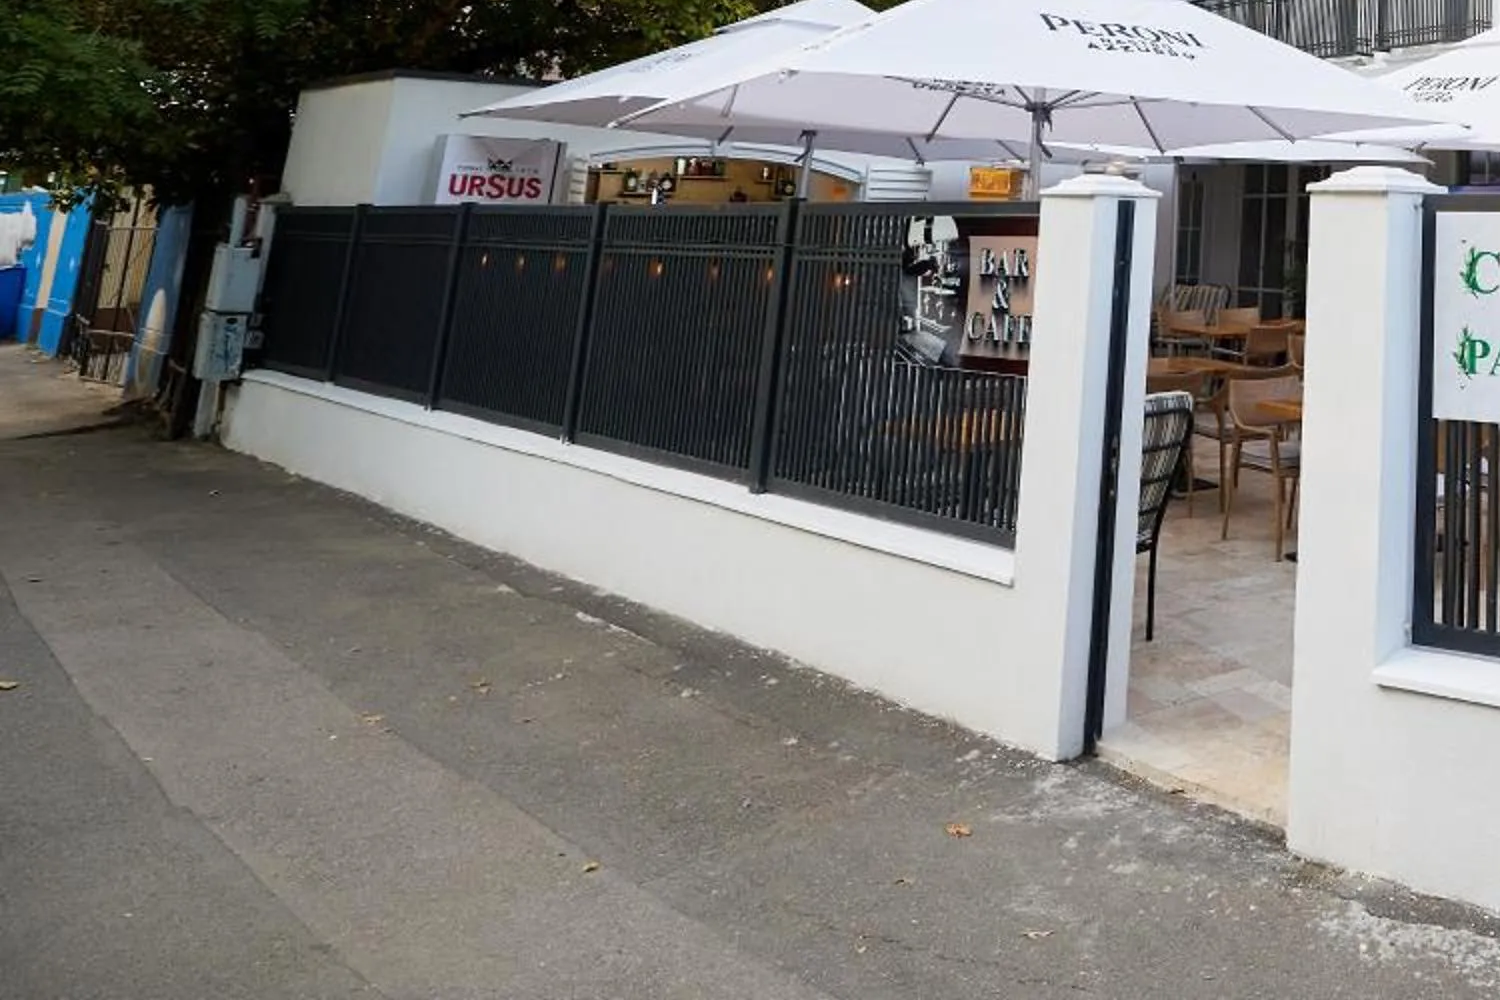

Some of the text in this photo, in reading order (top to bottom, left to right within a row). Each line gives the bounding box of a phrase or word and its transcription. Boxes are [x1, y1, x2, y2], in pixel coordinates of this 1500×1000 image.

[1039, 13, 1204, 48] PERONI
[448, 173, 542, 199] URSUS
[980, 248, 1030, 276] BAR
[992, 277, 1009, 309] &
